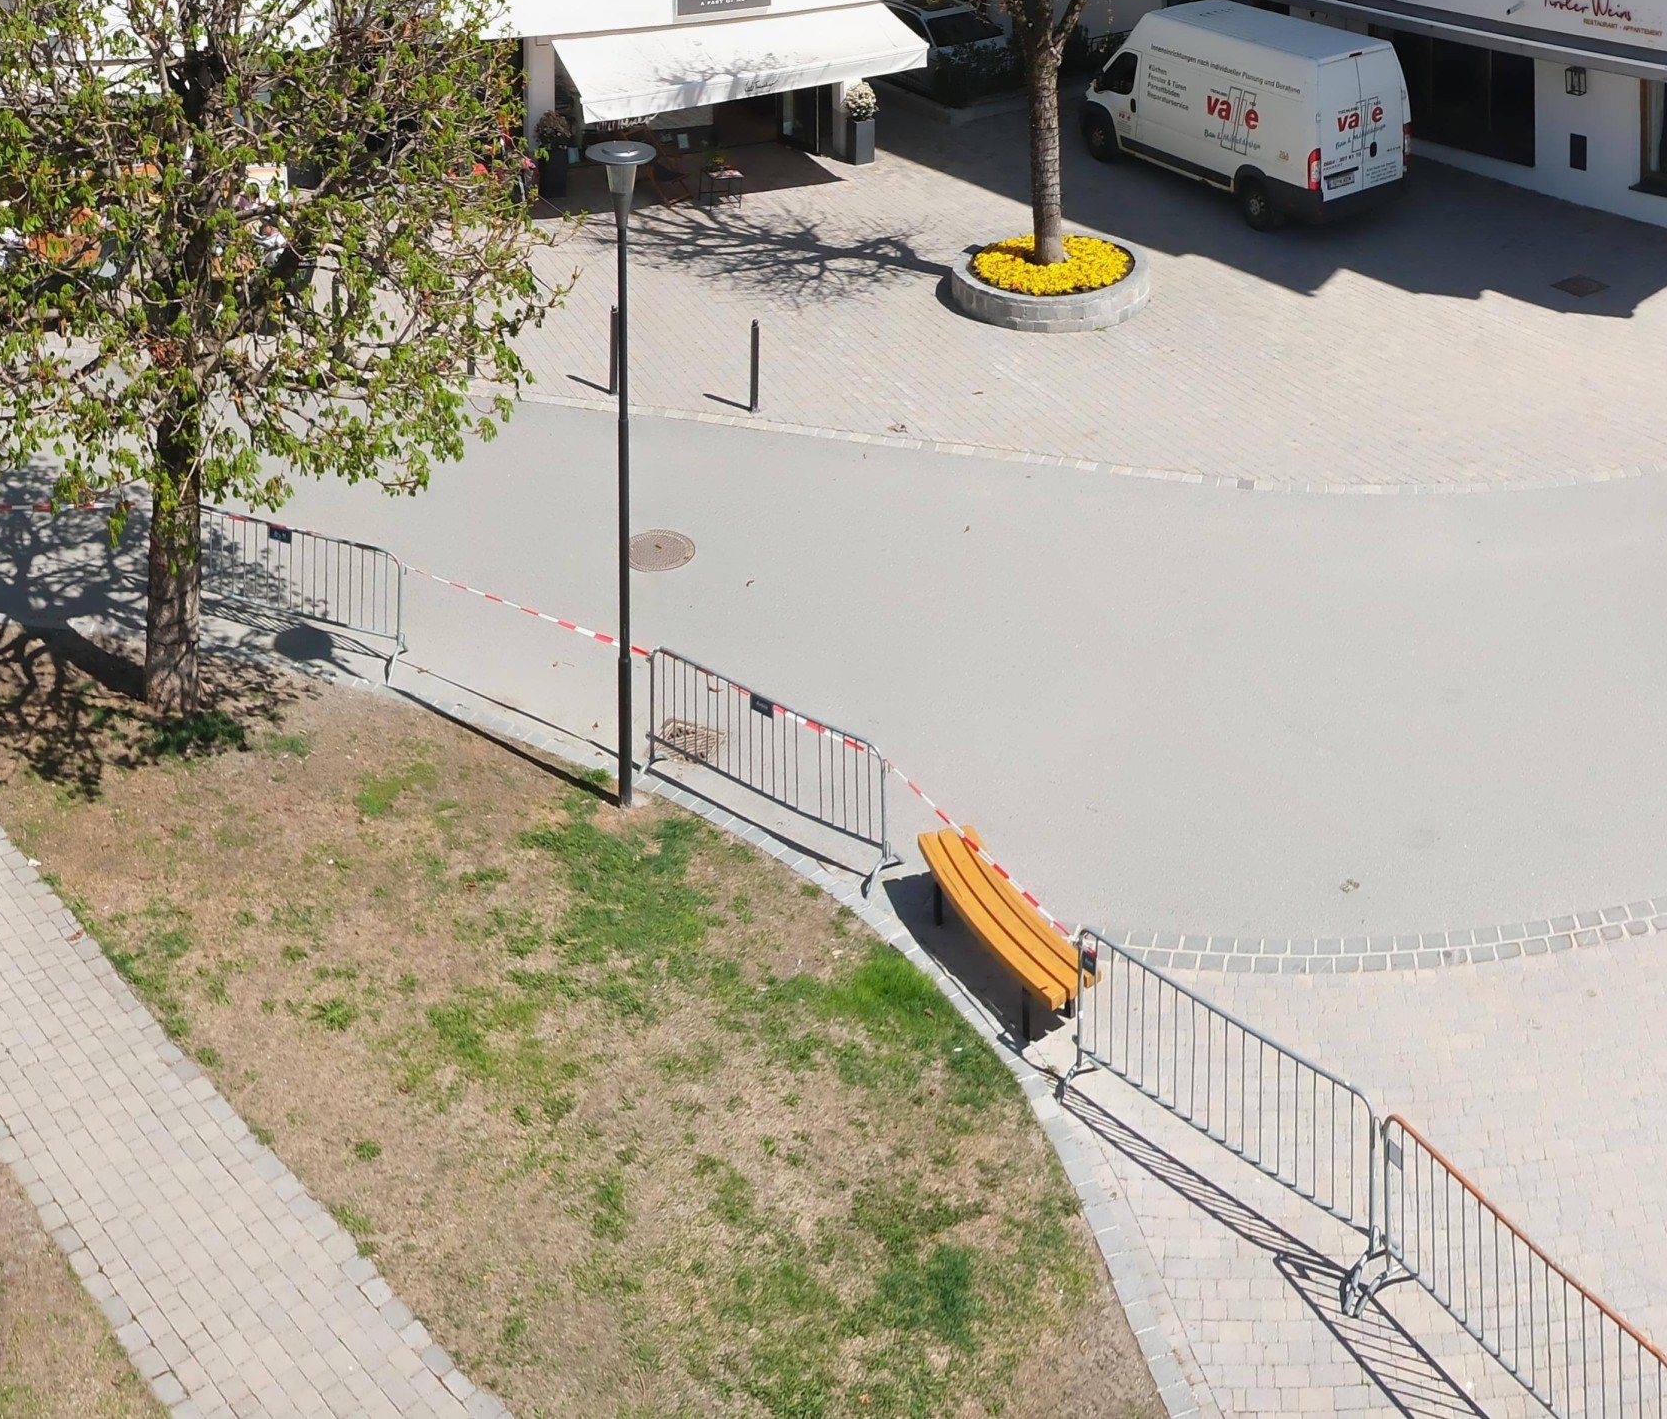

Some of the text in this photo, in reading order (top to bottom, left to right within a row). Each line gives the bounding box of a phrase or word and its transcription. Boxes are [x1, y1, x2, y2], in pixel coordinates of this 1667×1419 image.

[1583, 18, 1618, 30] RESTAURANT
[1622, 24, 1663, 37] APPARTEMENT
[1148, 64, 1168, 76] Küchen
[1197, 57, 1210, 68] nach
[1210, 60, 1242, 77] individueller
[1242, 71, 1264, 86] Planung
[1264, 78, 1275, 88] und
[1147, 82, 1181, 99] Parkettböden
[1148, 73, 1167, 85] Fenster
[1172, 79, 1187, 92] Türen
[1147, 91, 1190, 111] Reparaturservice
